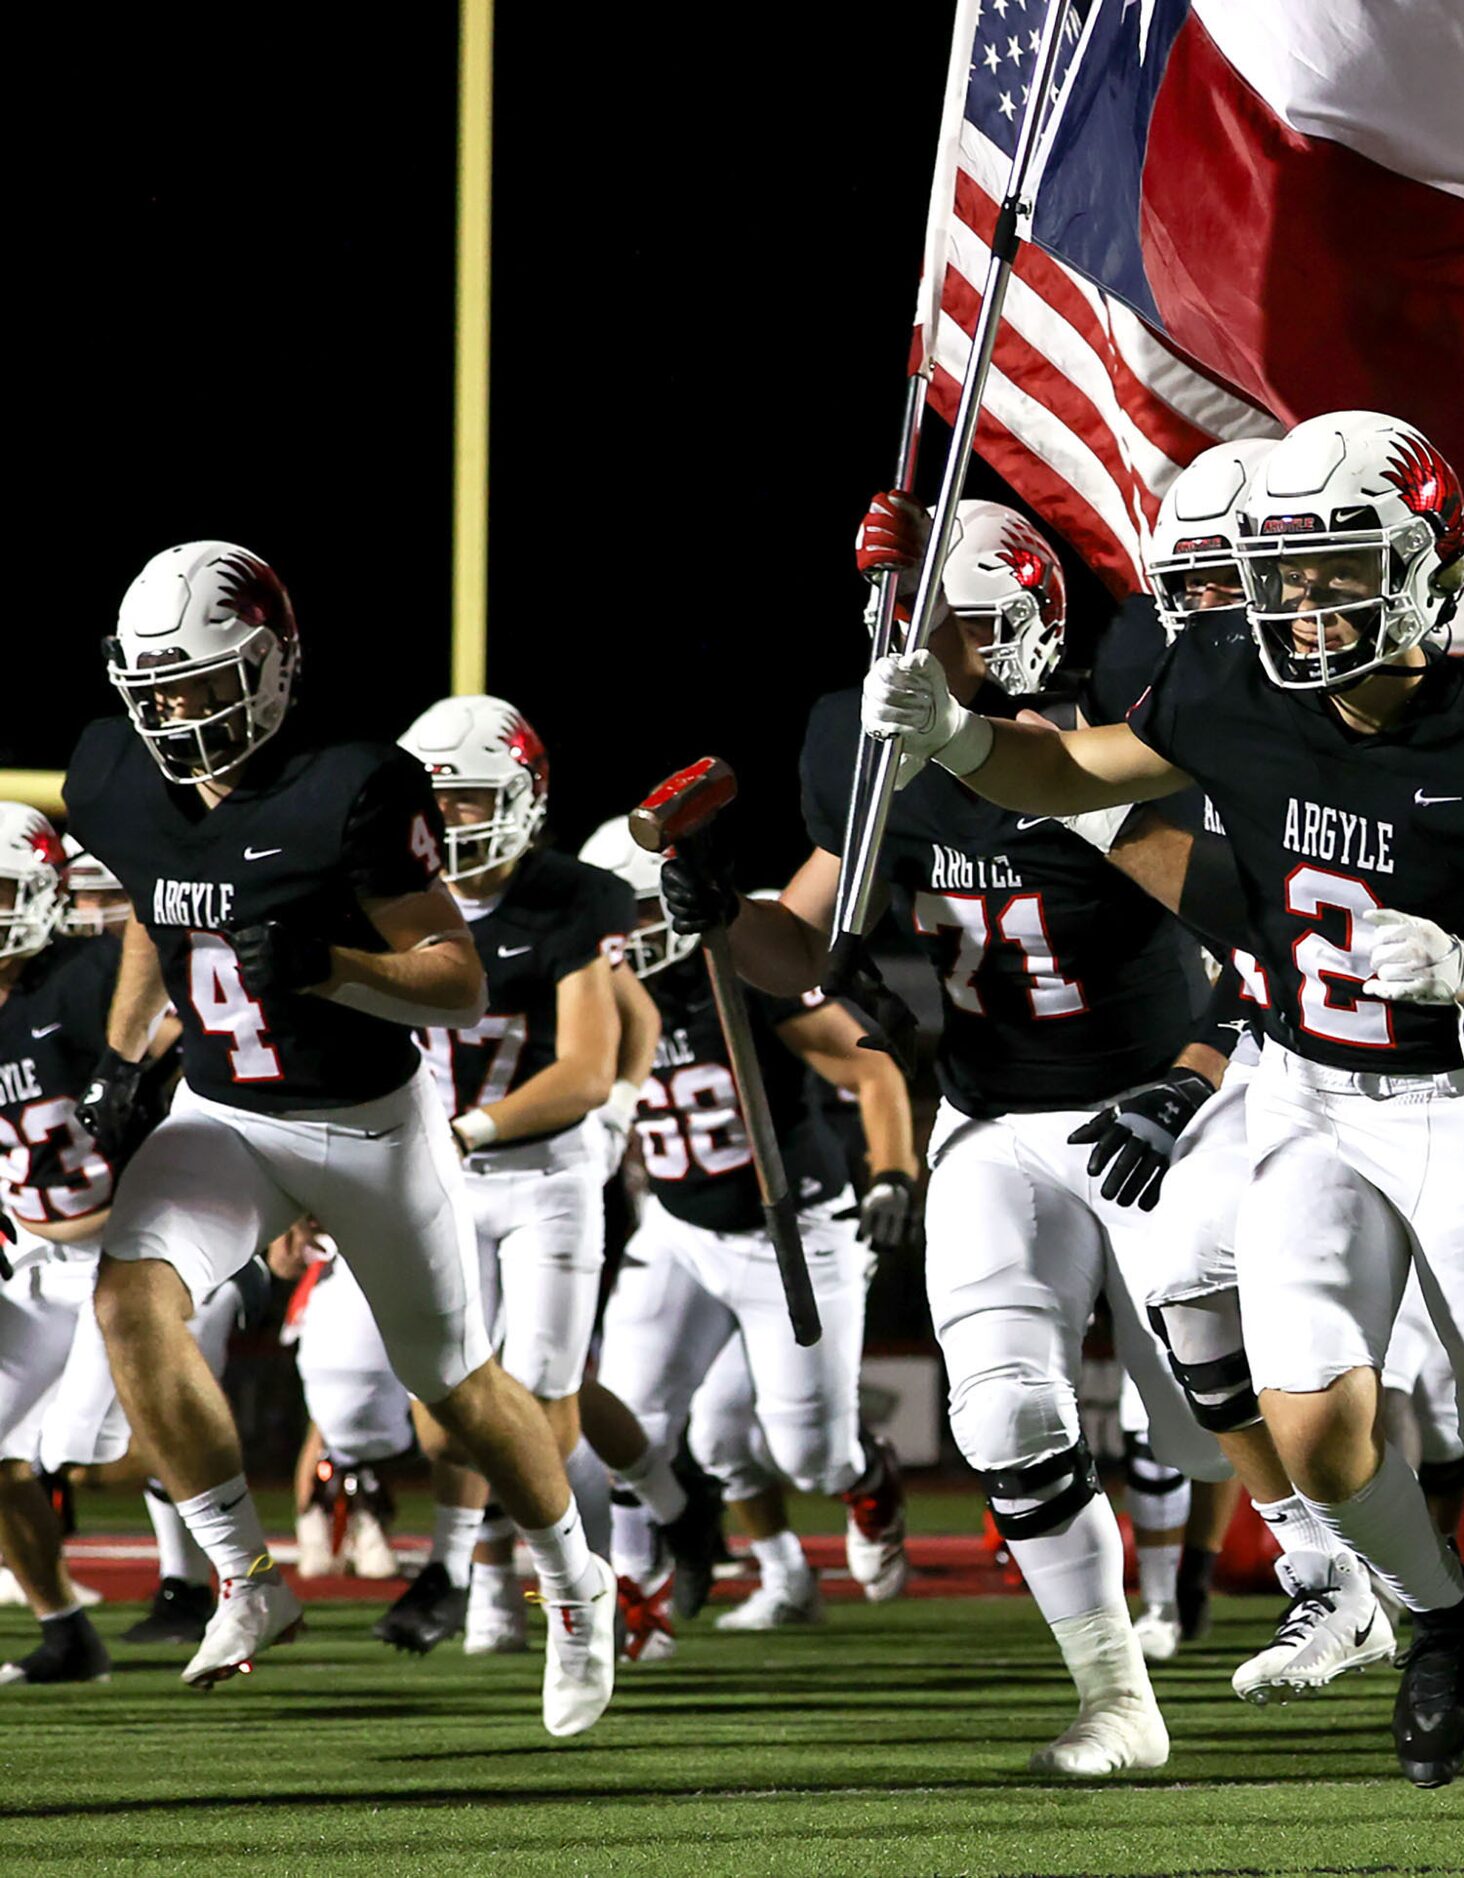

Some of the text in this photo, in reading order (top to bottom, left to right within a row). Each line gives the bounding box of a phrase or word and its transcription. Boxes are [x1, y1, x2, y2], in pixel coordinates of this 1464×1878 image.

[411, 814, 442, 872] 4
[1283, 797, 1396, 874] ARGYLE
[153, 878, 235, 929] ARGYLE
[913, 891, 1088, 1019] 71
[1284, 861, 1397, 1049] 2
[187, 929, 284, 1082] 4
[634, 1062, 755, 1182] 68
